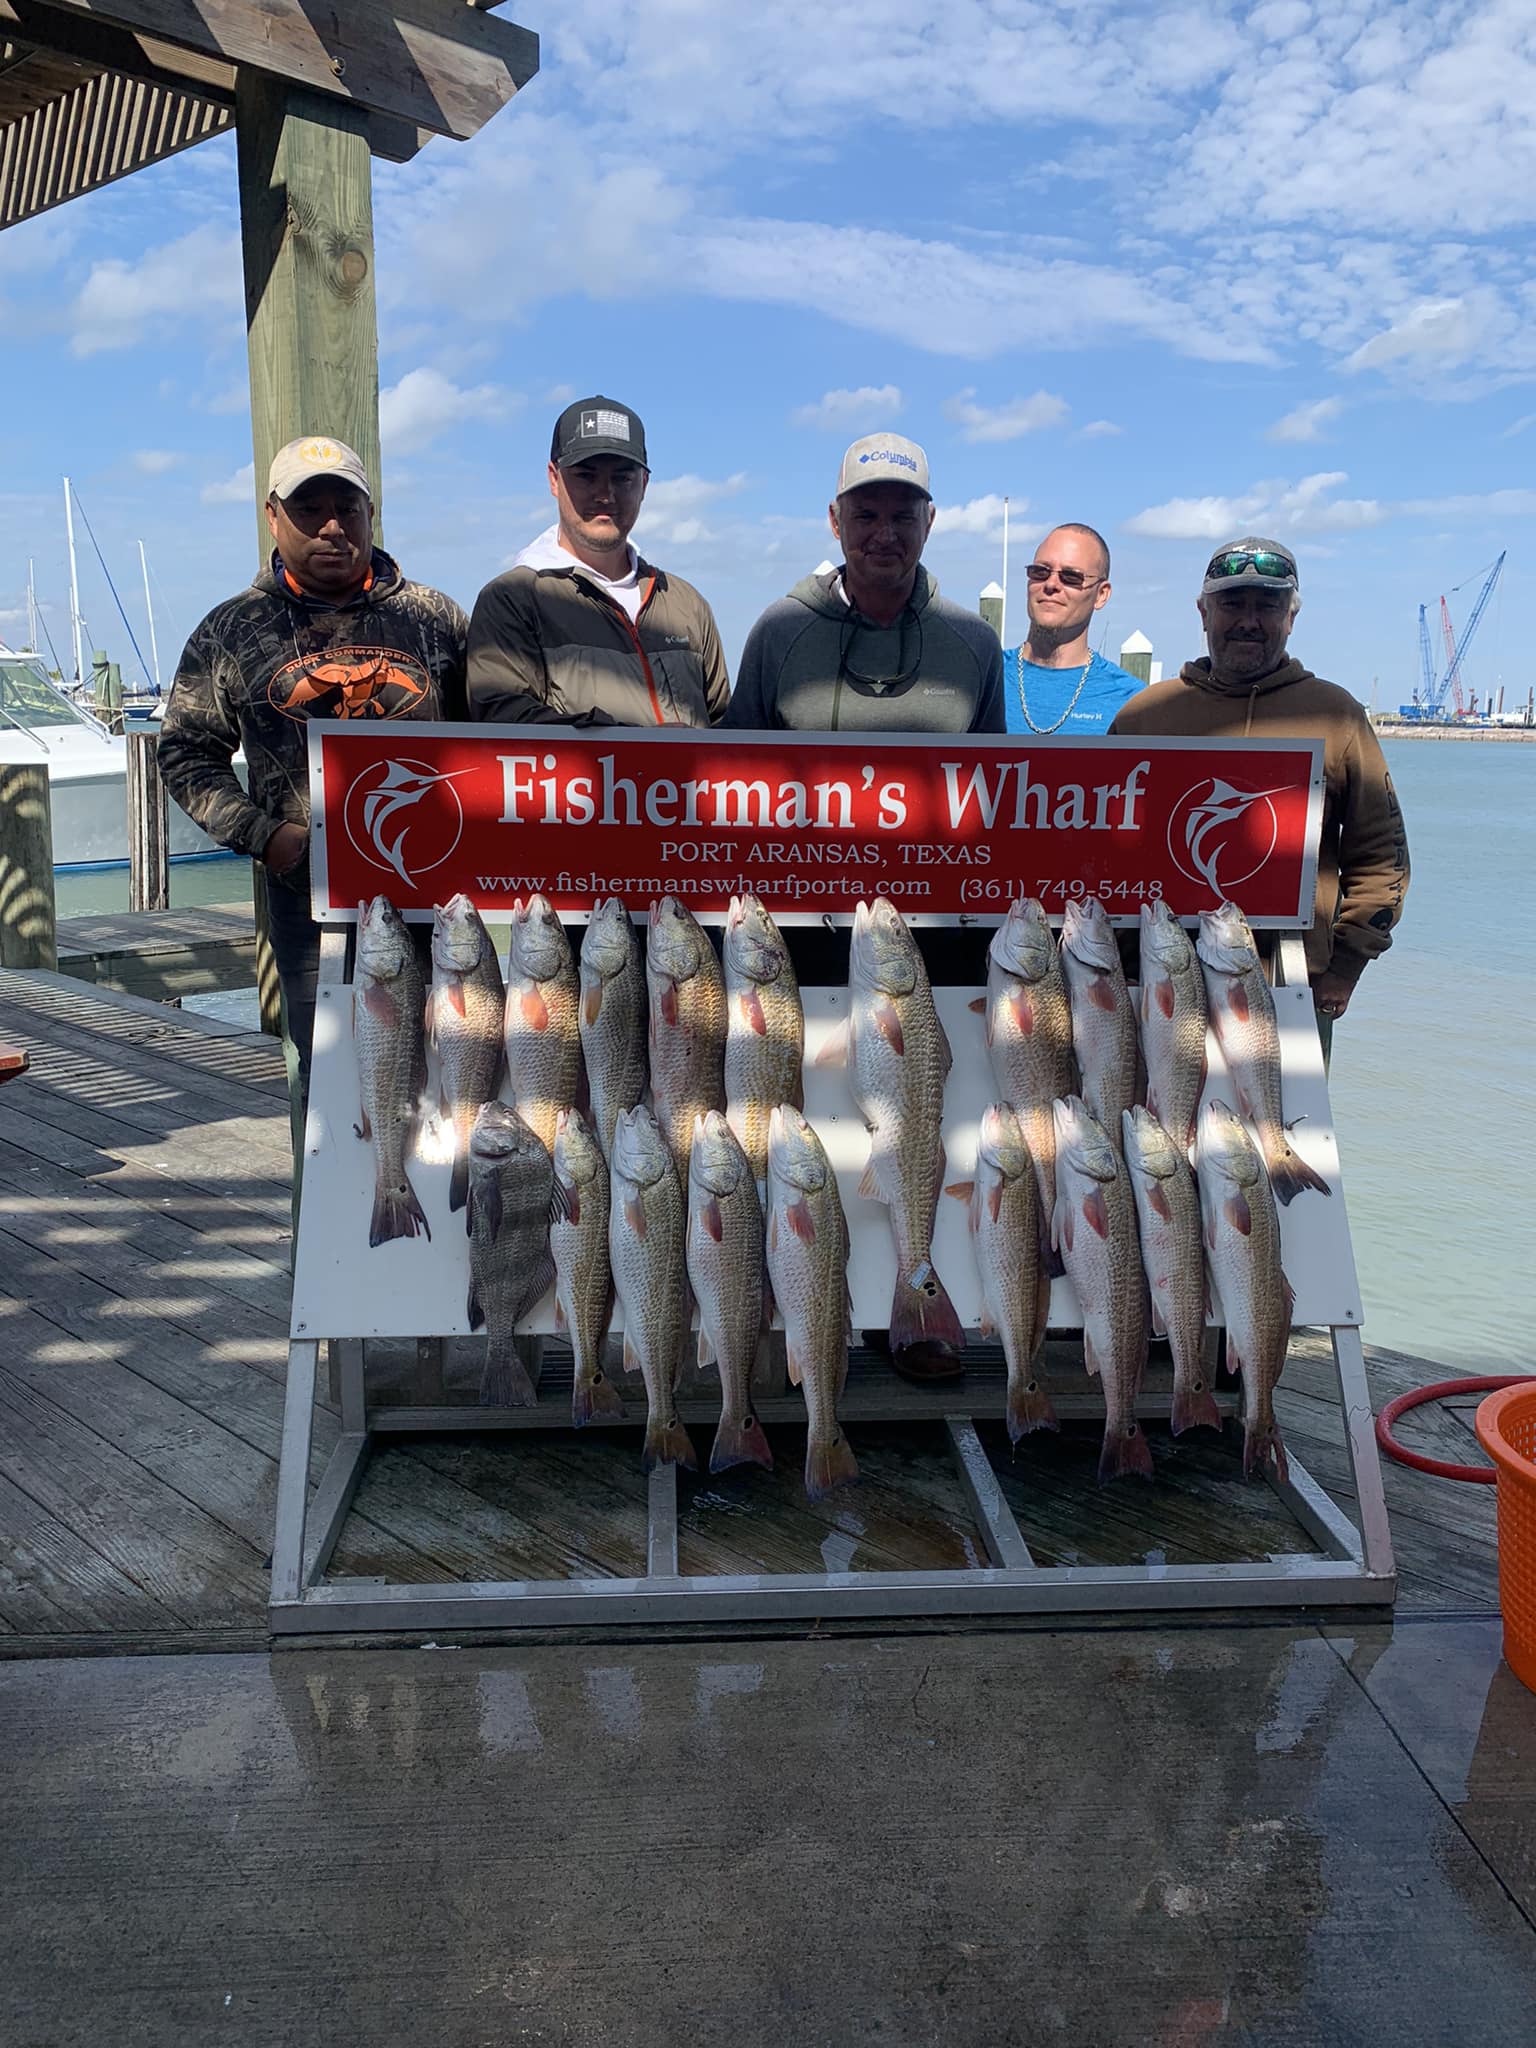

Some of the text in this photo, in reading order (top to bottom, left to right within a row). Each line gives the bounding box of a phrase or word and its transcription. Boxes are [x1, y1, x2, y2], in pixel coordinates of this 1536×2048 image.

[870, 450, 918, 472] Columbia
[286, 648, 411, 674] DUCK COMMANDER
[1071, 712, 1096, 721] Hurley
[496, 753, 1151, 831] Fisherman’s Wharf
[660, 841, 992, 867] PORT ARANSAS, TEXAS
[476, 871, 1164, 904] www.fishermanswharfporta.com (361) 749-5448
